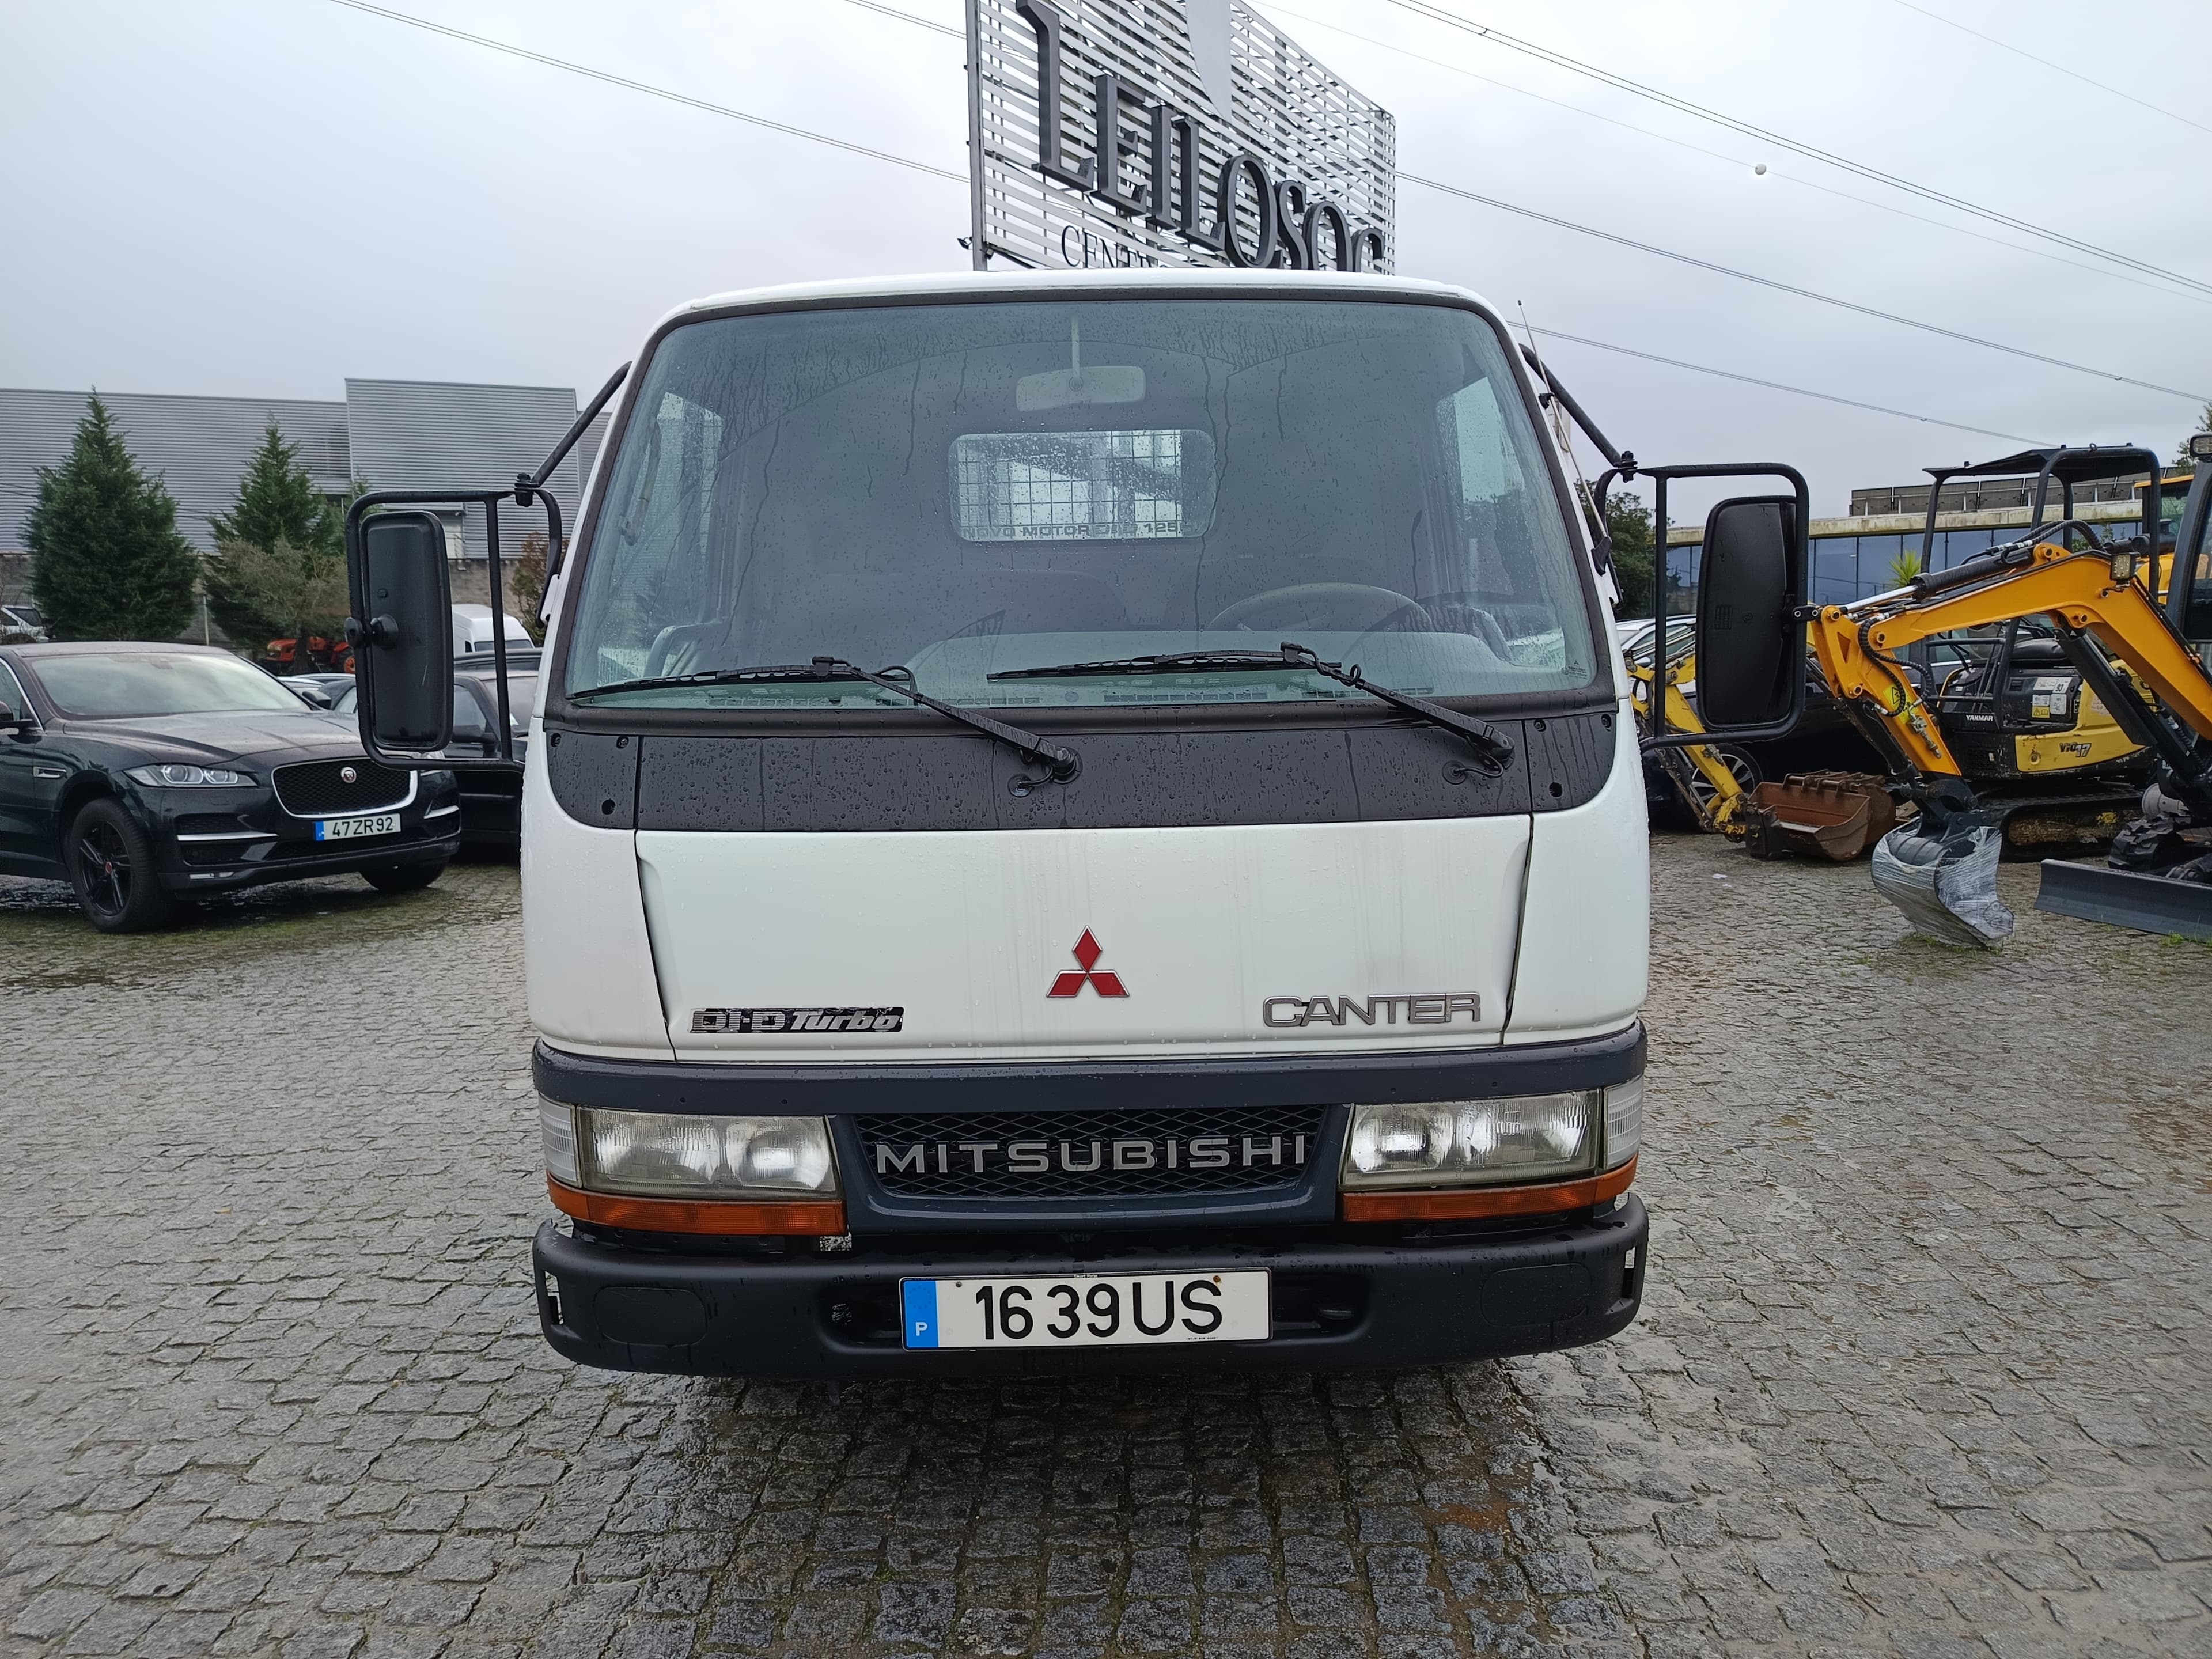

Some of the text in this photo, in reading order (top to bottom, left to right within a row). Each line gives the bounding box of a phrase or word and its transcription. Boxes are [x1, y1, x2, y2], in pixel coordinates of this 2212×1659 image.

[1062, 225, 1168, 268] CENT
[1022, 525, 1090, 536] MOTOR
[789, 1010, 901, 1030] Turbo
[1263, 991, 1480, 1028] CANTER
[876, 1132, 1305, 1173] MITSUBISHI
[915, 1321, 927, 1336] P
